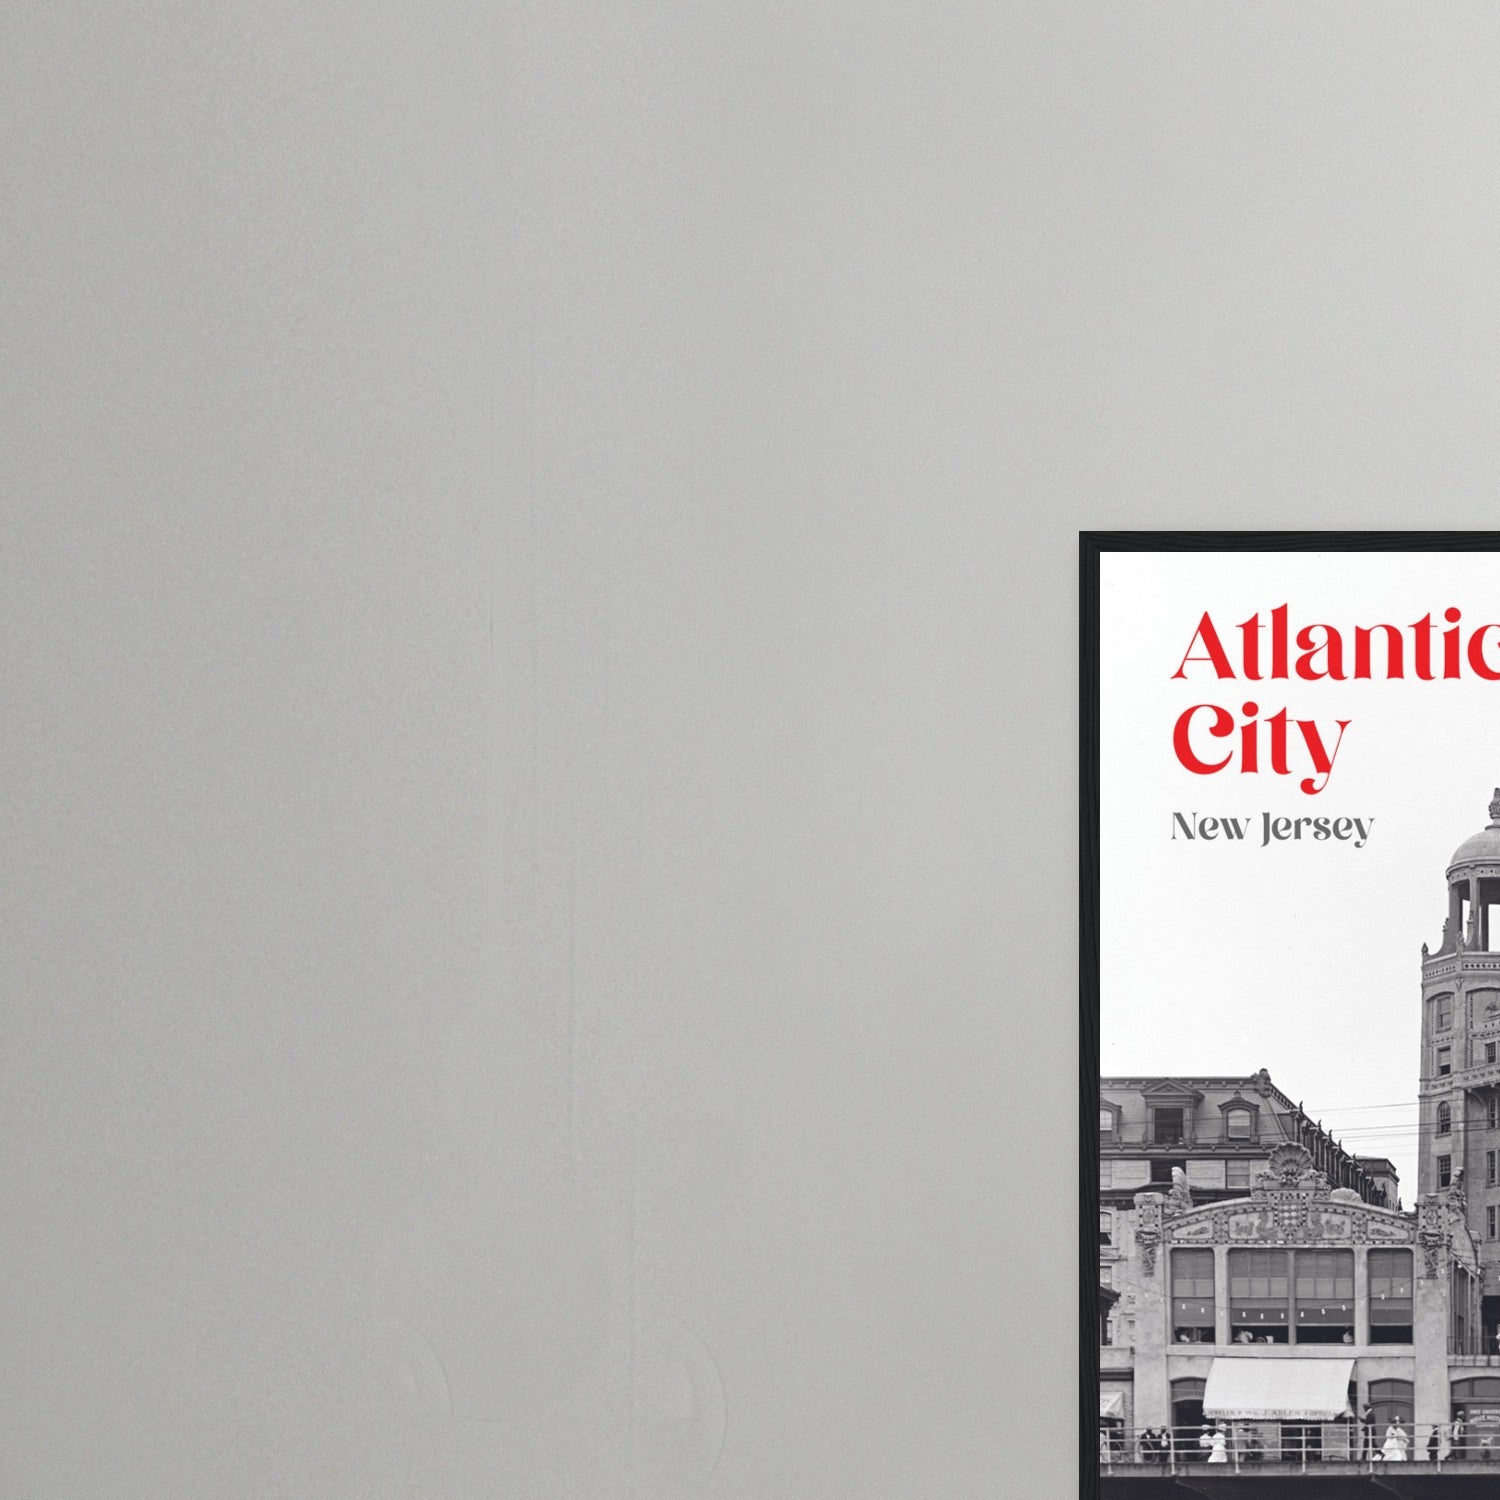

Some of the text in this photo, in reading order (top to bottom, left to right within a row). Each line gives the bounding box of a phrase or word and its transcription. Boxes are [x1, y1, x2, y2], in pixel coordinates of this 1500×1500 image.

[1173, 701, 1352, 795] City
[1172, 812, 1374, 848] New Jersey
